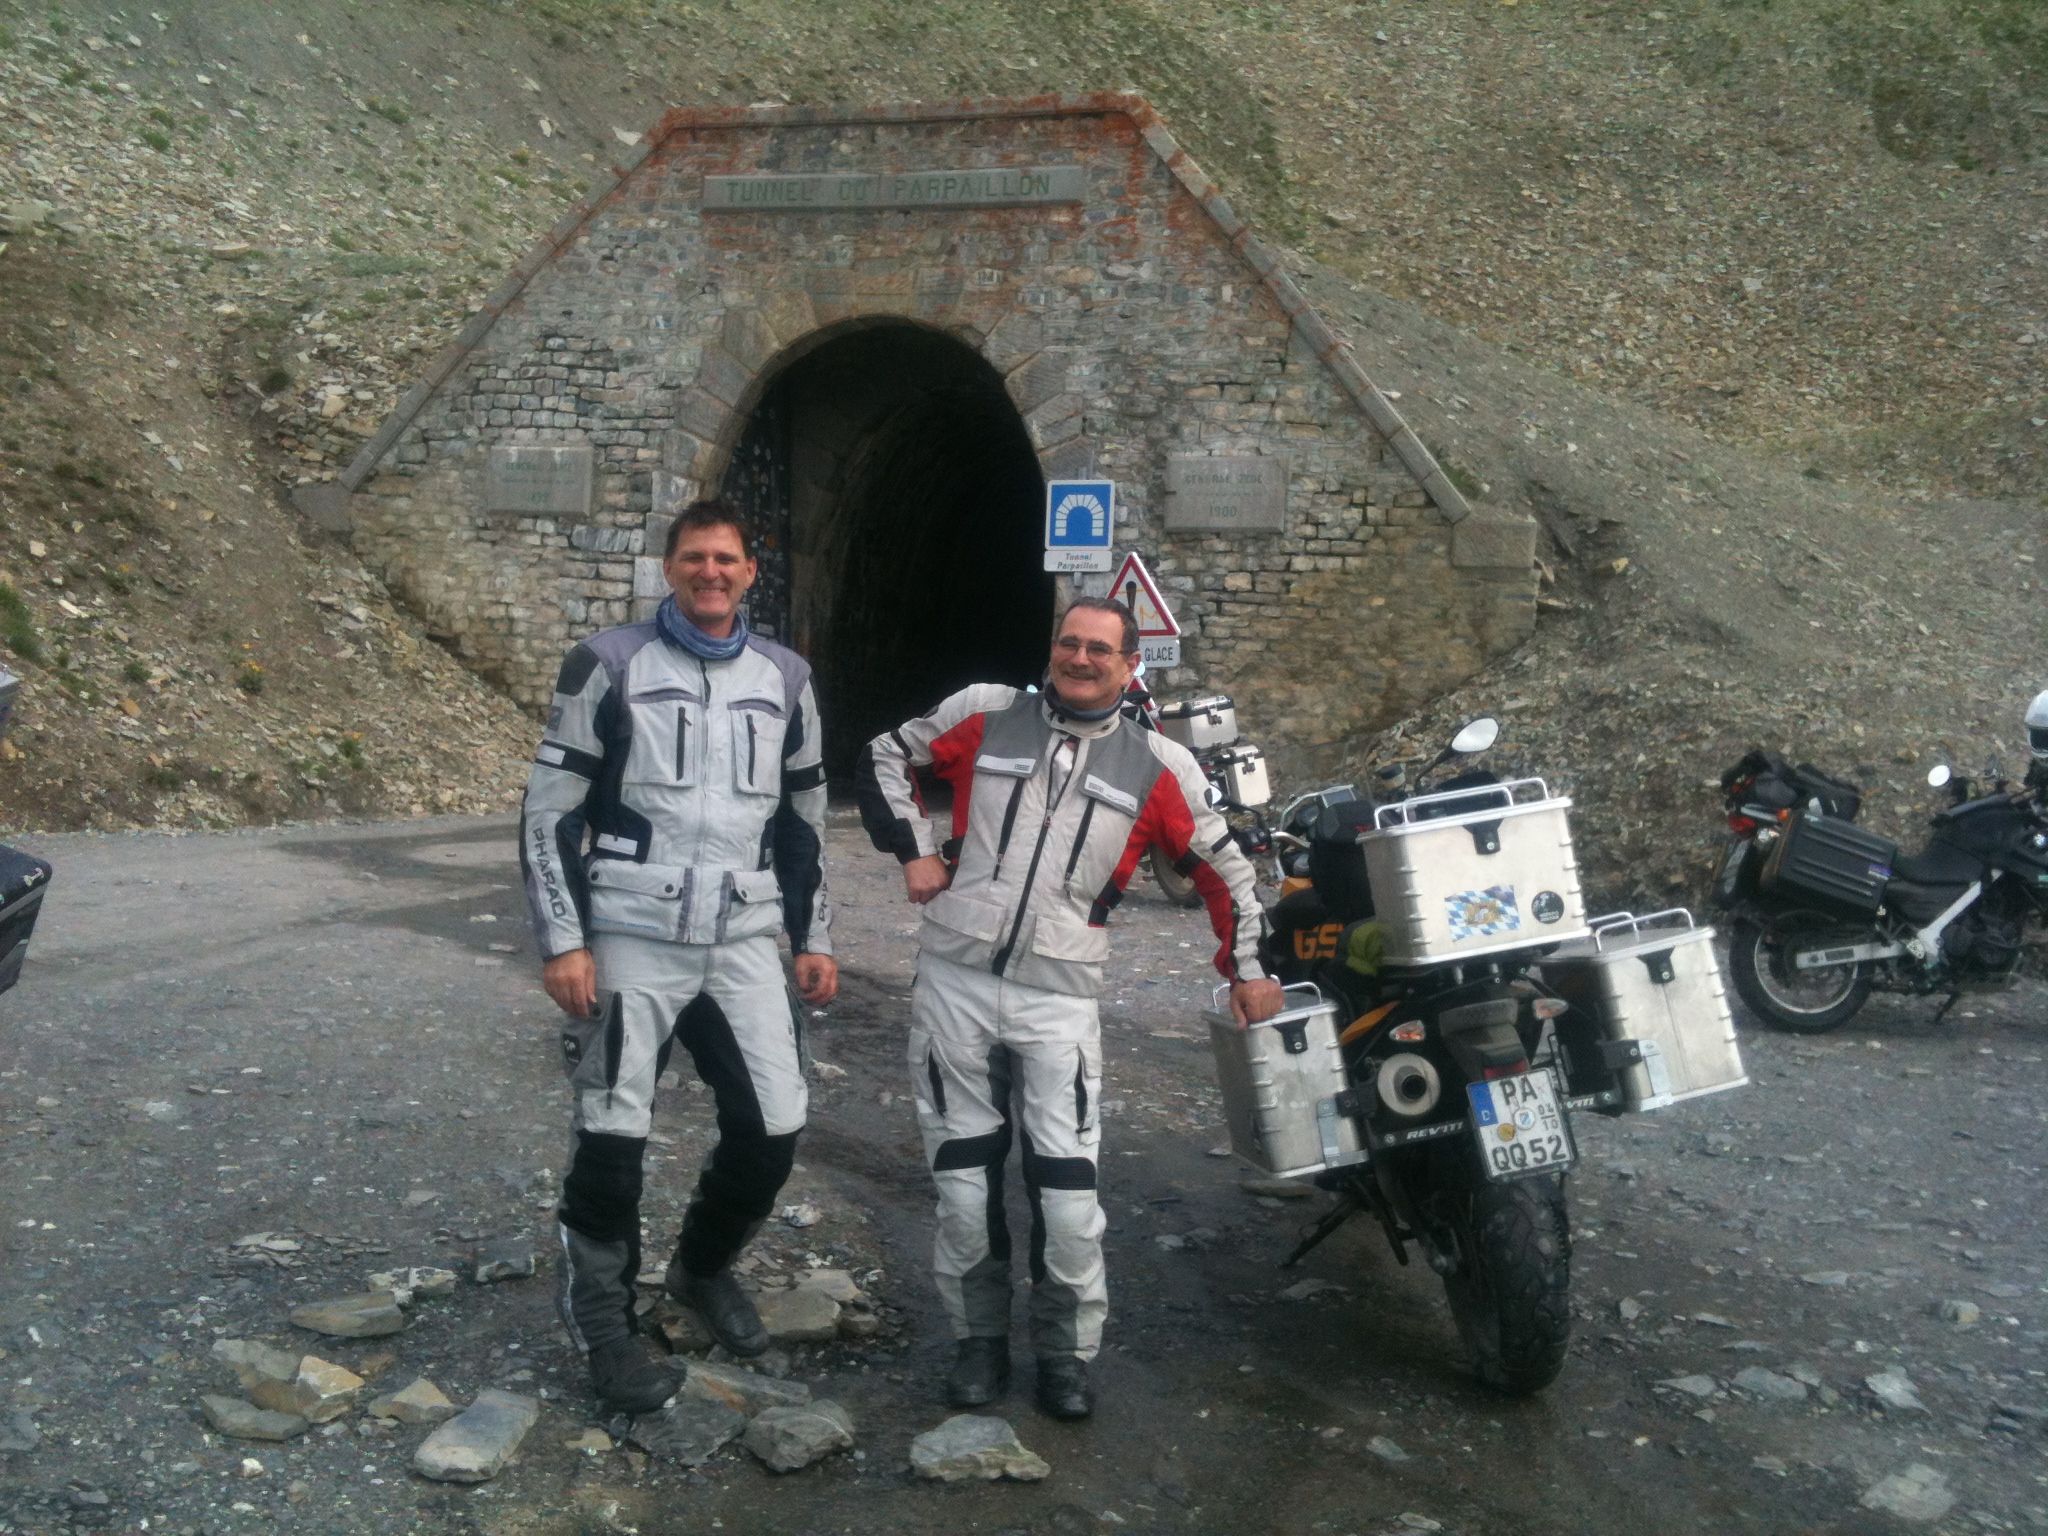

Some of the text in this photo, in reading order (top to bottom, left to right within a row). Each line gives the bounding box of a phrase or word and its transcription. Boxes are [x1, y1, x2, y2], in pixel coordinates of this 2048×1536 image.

[726, 181, 813, 202] TUNNEL
[893, 174, 1051, 200] PARPAILLON
[1057, 561, 1099, 570] Parpaillon
[1065, 552, 1092, 561] Tunnel
[1144, 646, 1174, 662] GLACE
[532, 826, 567, 918] PHARAO
[1293, 923, 1344, 960] GS
[1499, 1075, 1539, 1106] PA
[1481, 1109, 1491, 1121] D
